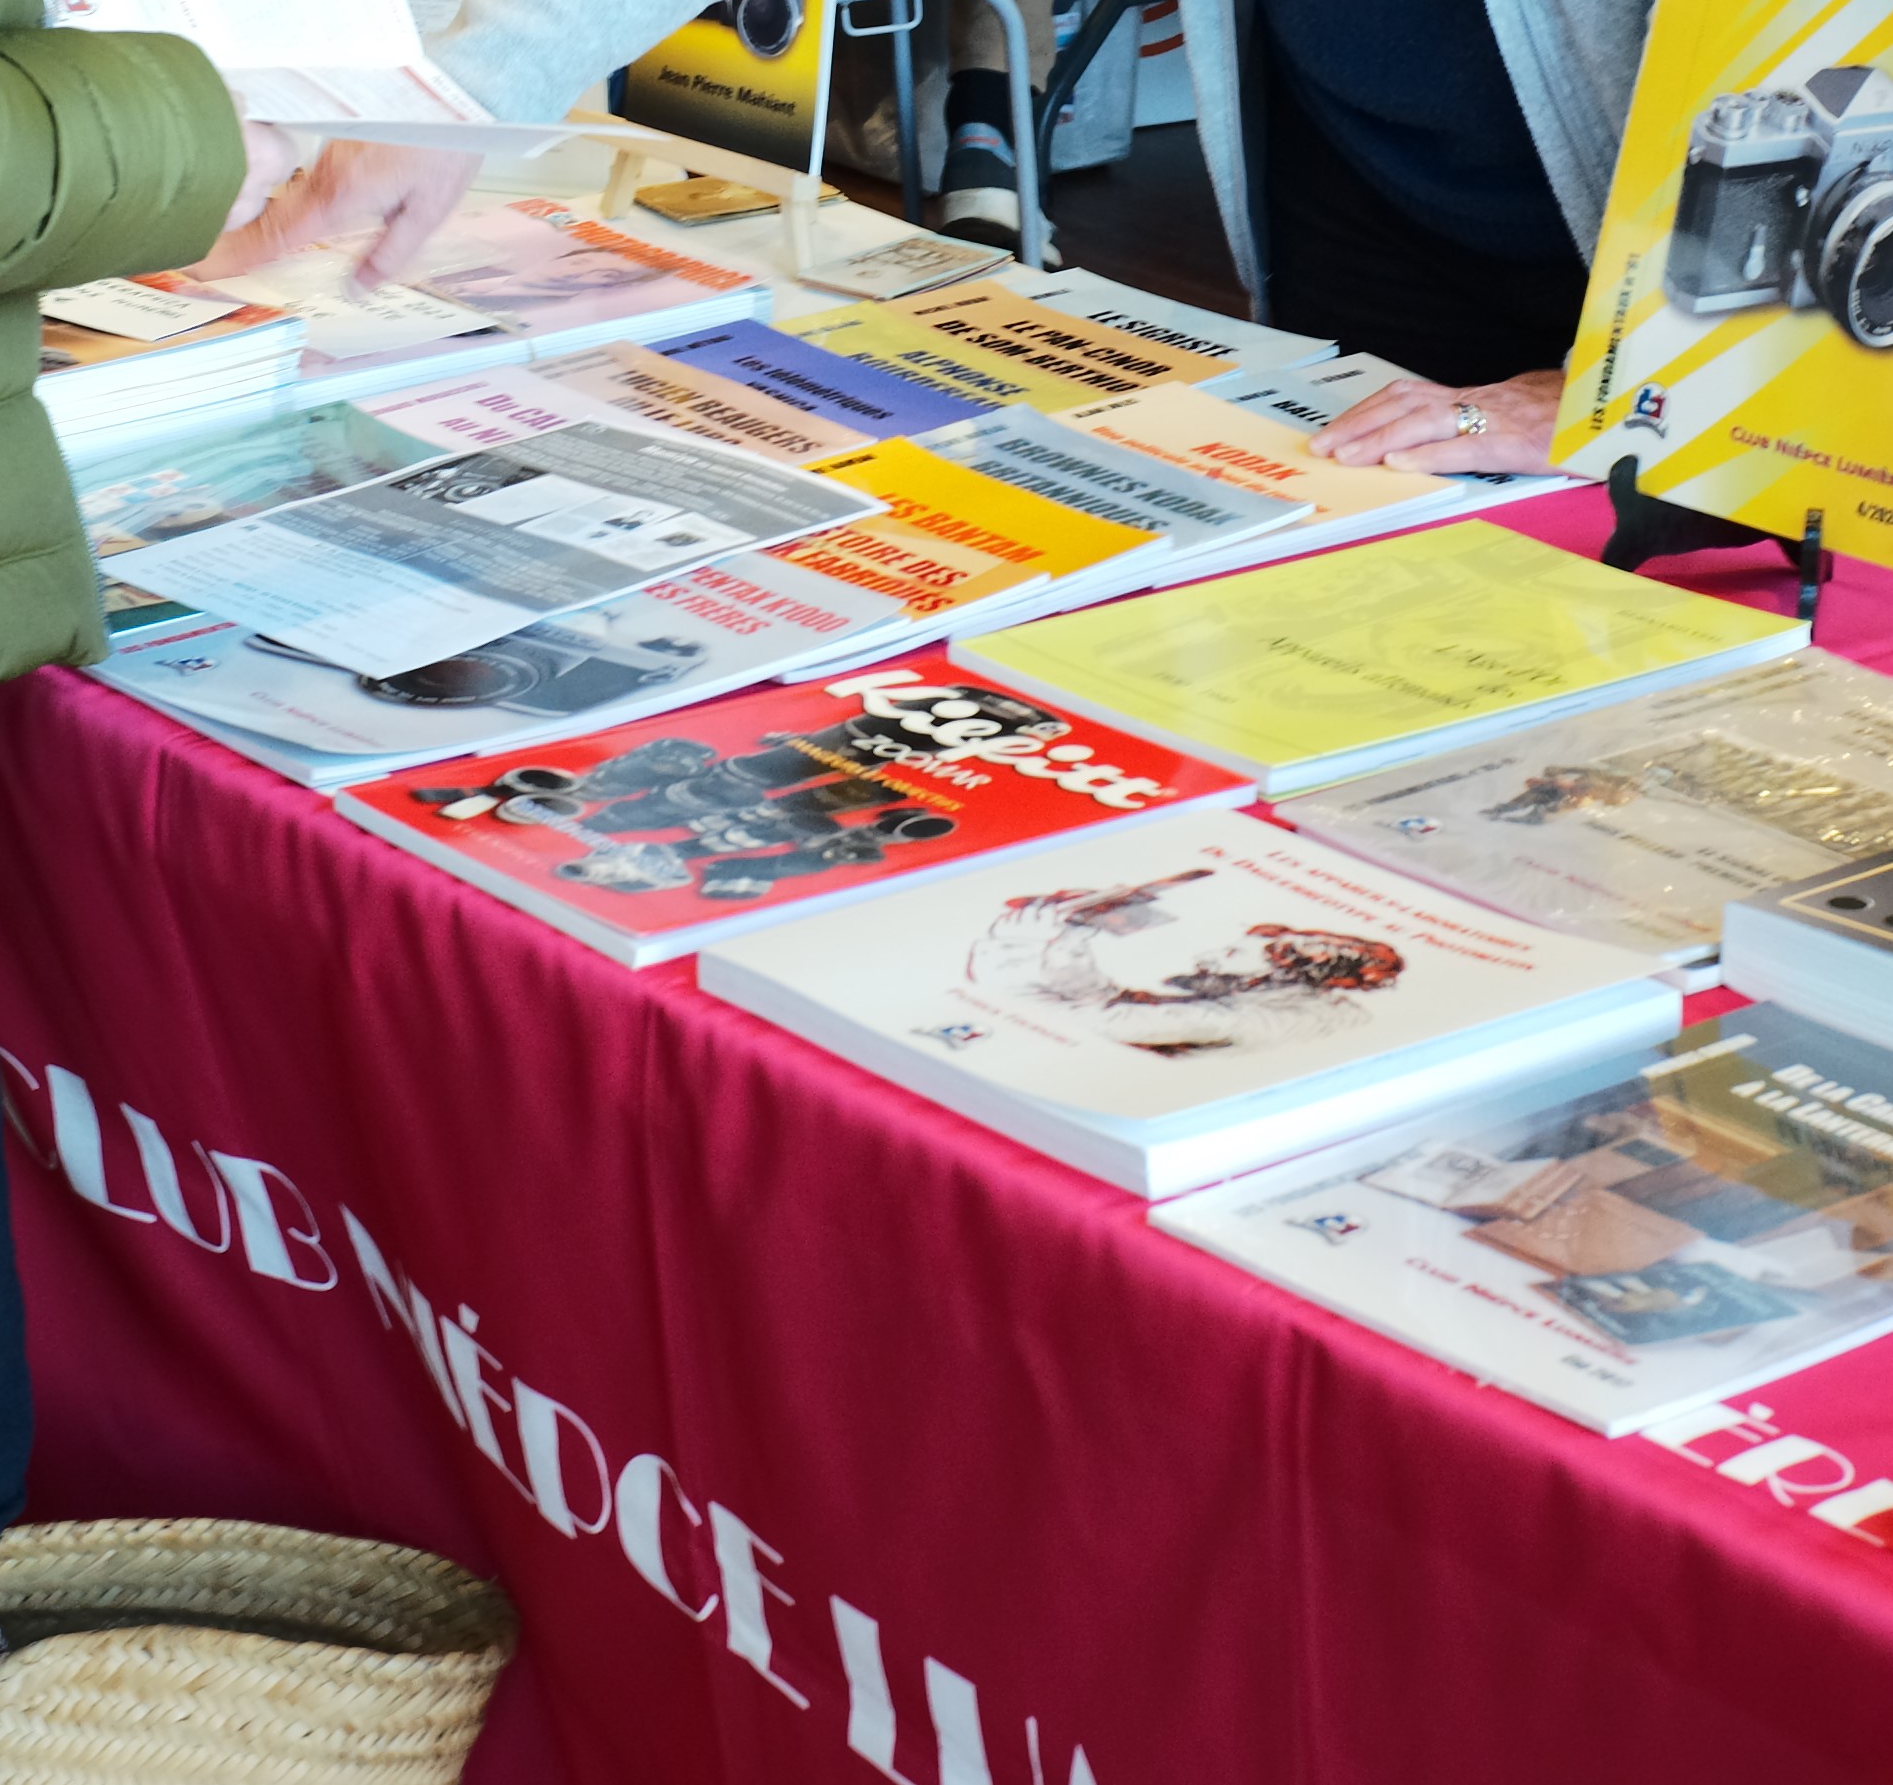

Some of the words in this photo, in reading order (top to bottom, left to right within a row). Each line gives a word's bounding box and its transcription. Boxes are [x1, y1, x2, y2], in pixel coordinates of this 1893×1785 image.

[928, 318, 983, 337] DE
[961, 328, 1149, 399] SOM-BERTHIO
[999, 318, 1046, 335] LE
[1027, 325, 1175, 380] PAN-CINOR
[1084, 308, 1129, 324] LE
[1112, 317, 1240, 360] SIGRISTE
[729, 354, 778, 372] Les
[760, 364, 897, 424] télémétriques
[894, 345, 1030, 401] ALPHONSE
[605, 367, 708, 406] LUCIEN
[682, 398, 827, 455] BEAUGERS
[1729, 425, 1771, 452] CLUB
[992, 433, 1154, 497] BROWNIES
[1132, 484, 1249, 529] KODAK
[1186, 437, 1308, 487] KODAK
[969, 454, 1173, 535] BRITANNIQUES
[907, 511, 1048, 568] BANTAM
[891, 559, 977, 588] DES
[772, 598, 853, 634] K1000
[851, 733, 993, 791] ZOOMAR
[1720, 1078, 1778, 1098] A
[1743, 1089, 1810, 1112] LA
[1798, 1080, 1865, 1103] LA
